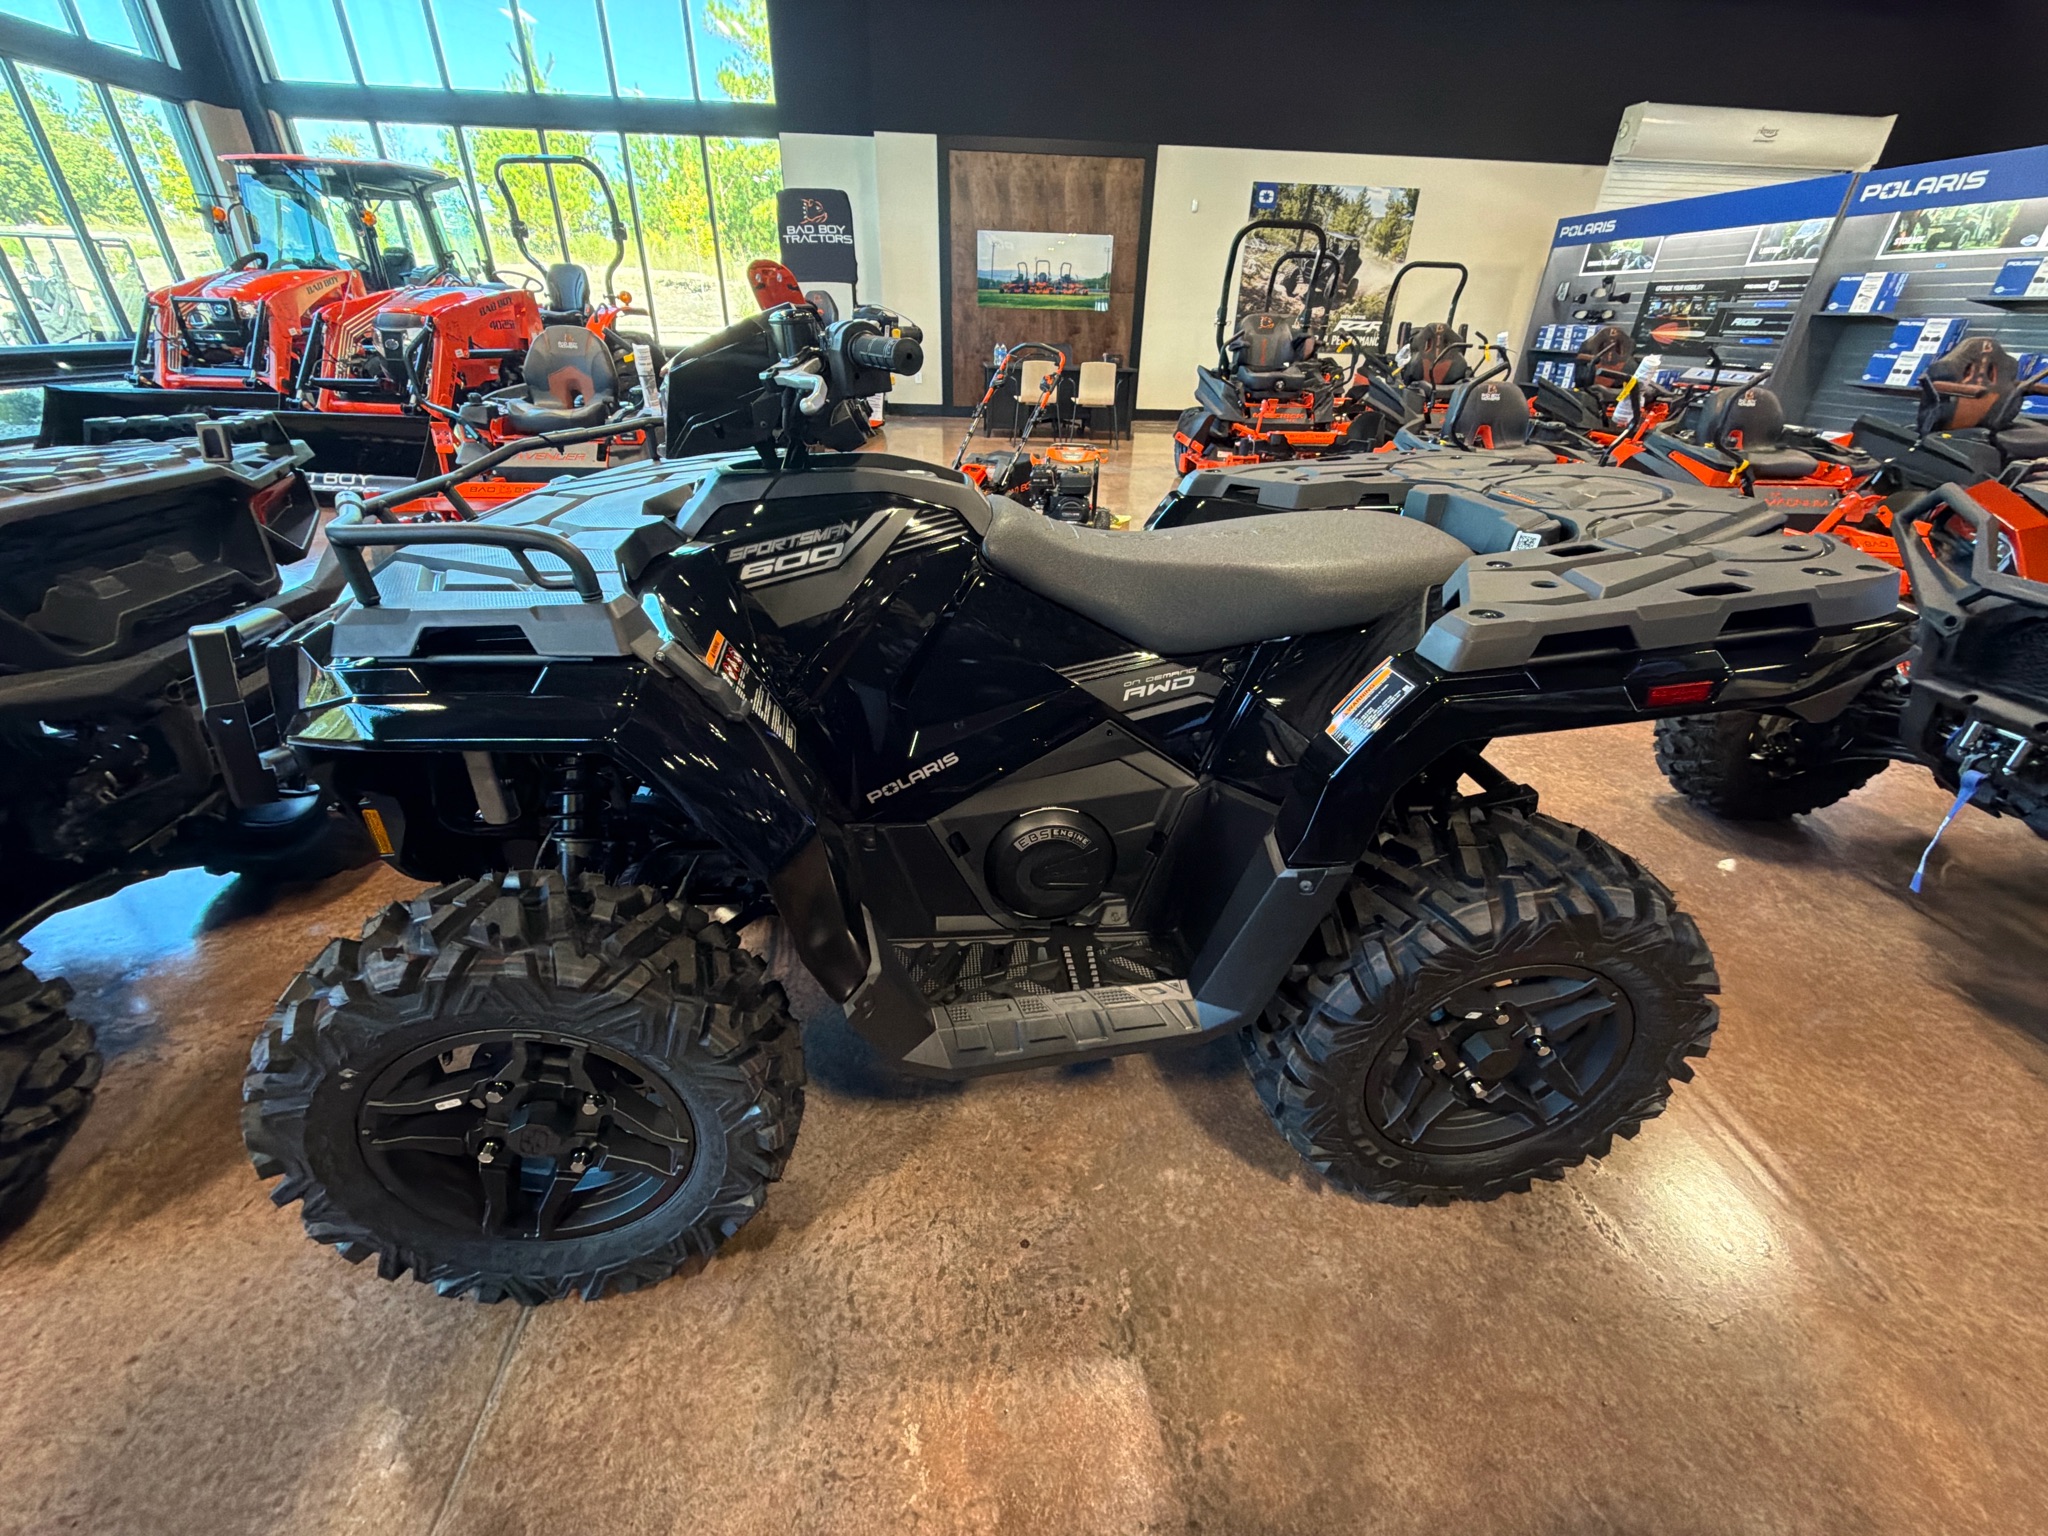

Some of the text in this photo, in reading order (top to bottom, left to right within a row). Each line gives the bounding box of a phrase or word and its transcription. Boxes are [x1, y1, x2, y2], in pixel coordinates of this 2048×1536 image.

[1859, 169, 1990, 203] POLARIS
[786, 224, 846, 235] BAD BOY
[1559, 219, 1617, 238] POLARIS
[782, 234, 853, 244] TRACTORS
[323, 472, 372, 485] BOY
[469, 486, 496, 494] BAD
[726, 519, 859, 563] SPORTSMAN
[740, 542, 845, 580] 600
[1145, 667, 1198, 683] DEMAND
[1123, 675, 1196, 702] AWD
[1346, 683, 1376, 712] WARNING
[866, 751, 960, 804] POLARIS
[1019, 829, 1090, 849] EBS ENGINE
